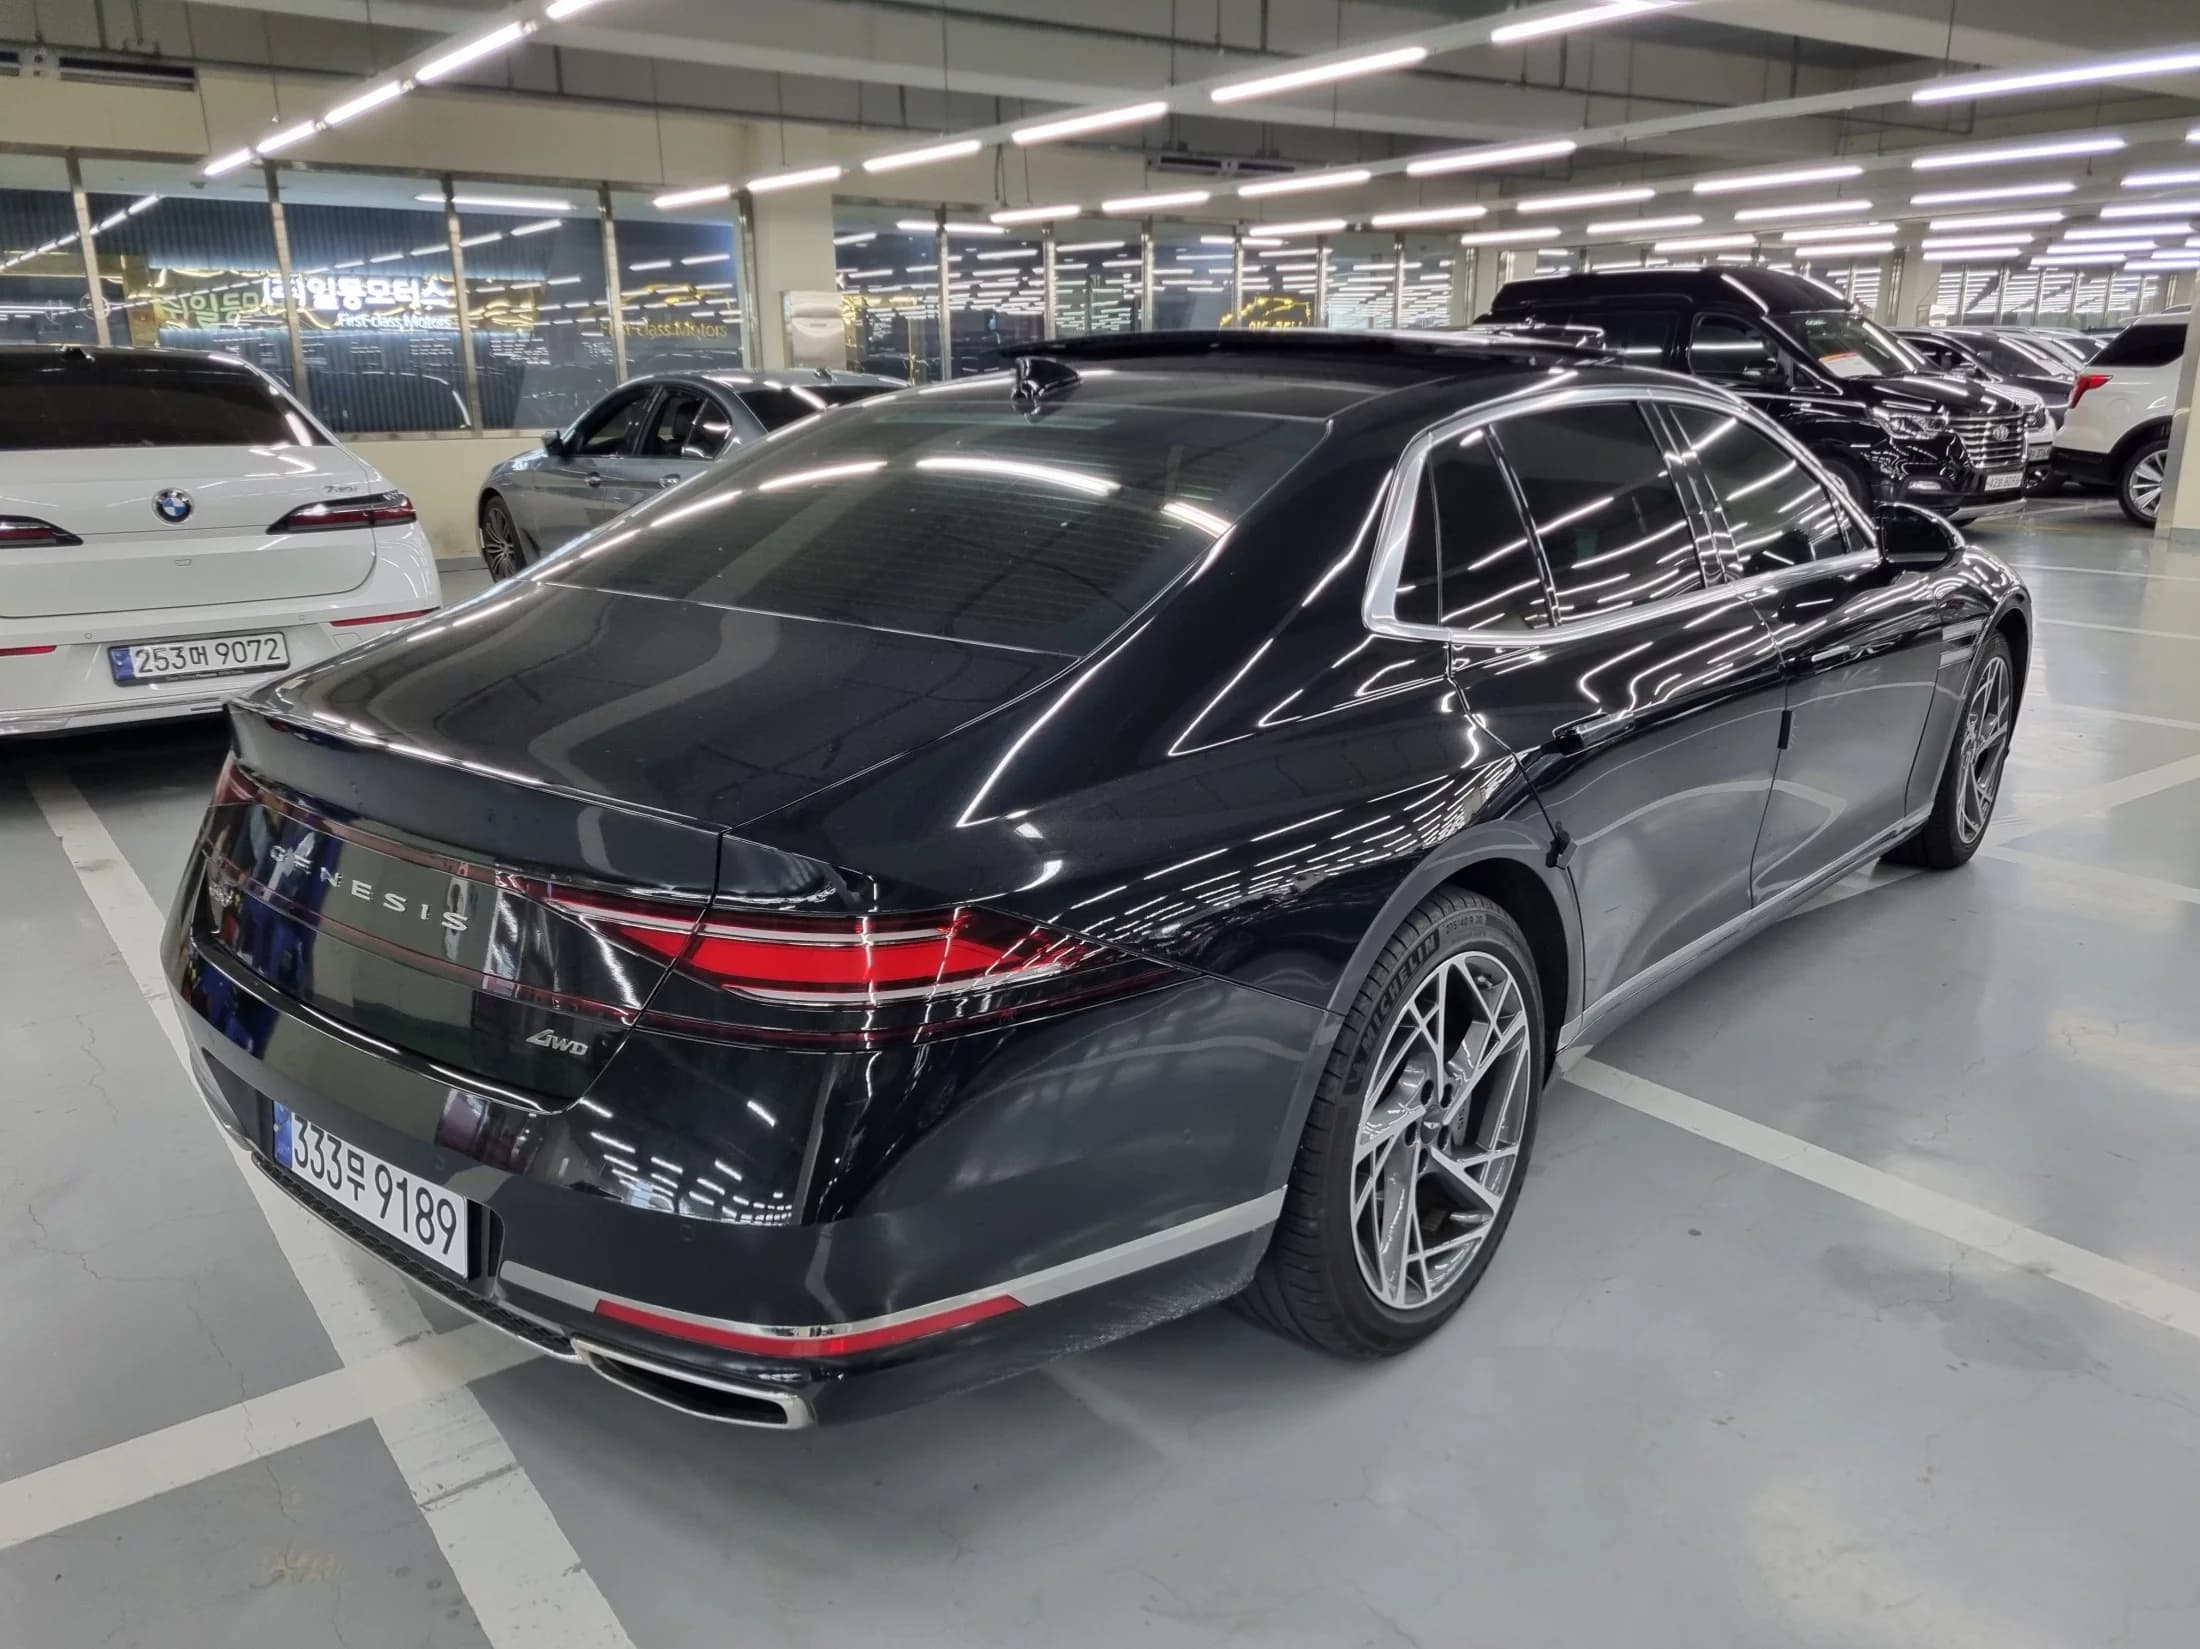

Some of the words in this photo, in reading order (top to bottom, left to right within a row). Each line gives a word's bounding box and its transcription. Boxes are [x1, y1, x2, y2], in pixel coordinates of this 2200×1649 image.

[135, 645, 209, 673] 253머
[215, 638, 281, 665] 9072
[270, 845, 469, 932] GENESIS
[1361, 930, 1439, 1049] MICHELIN
[295, 1113, 365, 1201] 333무
[375, 1164, 457, 1255] 9189
